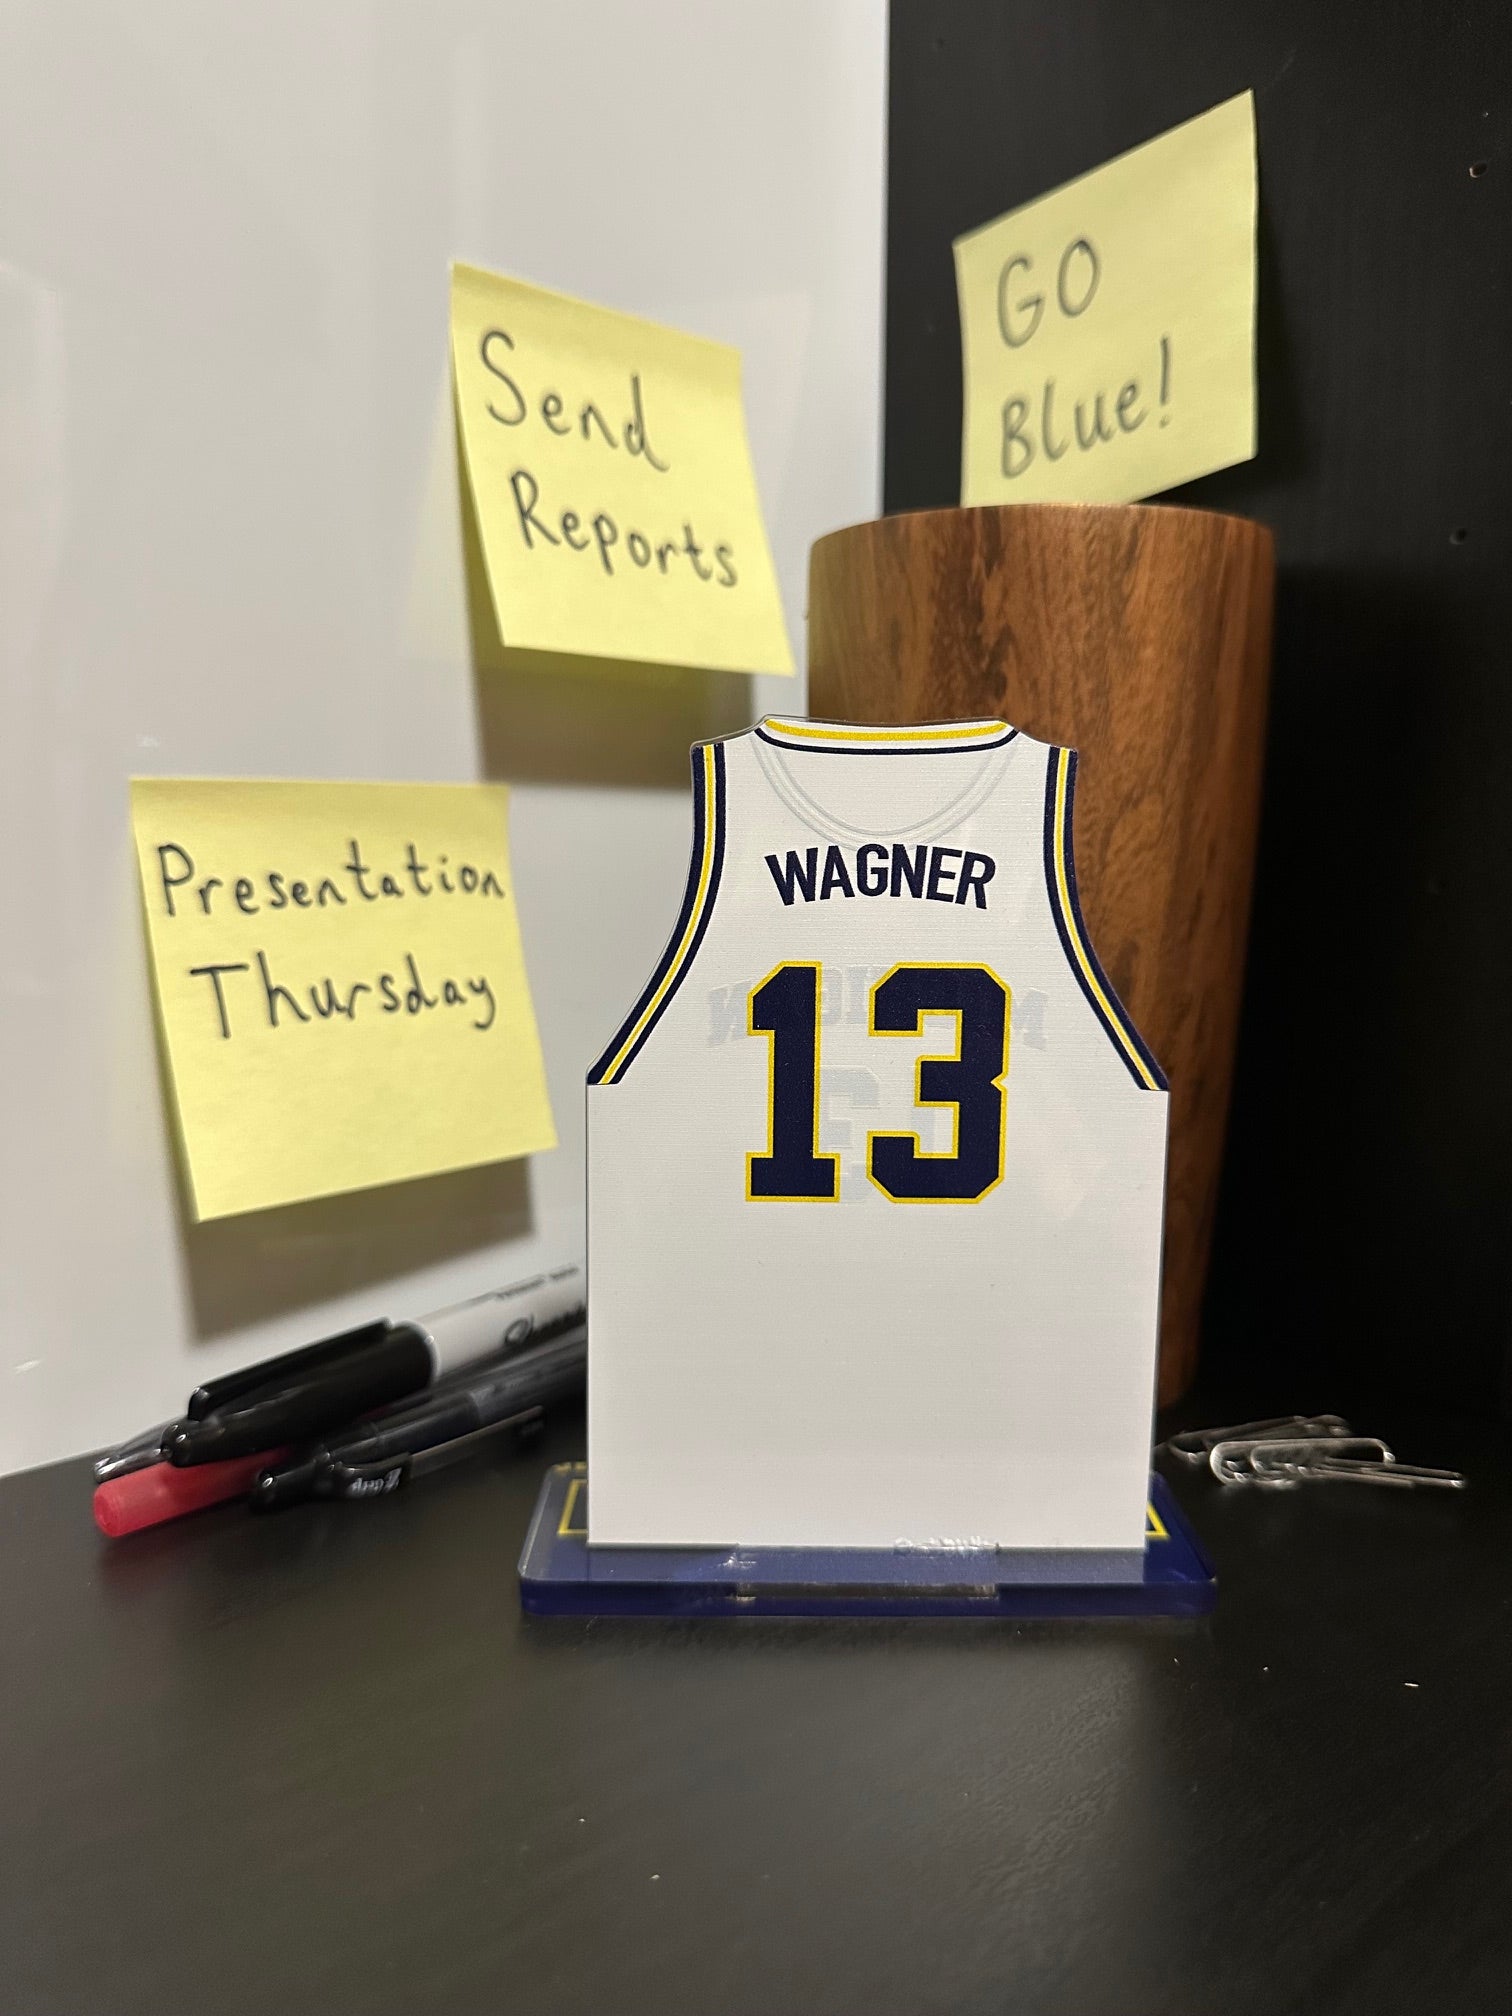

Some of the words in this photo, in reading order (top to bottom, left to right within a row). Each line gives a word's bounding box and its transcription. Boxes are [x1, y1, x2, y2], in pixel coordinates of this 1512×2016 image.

[997, 236, 1100, 348] GO
[480, 328, 671, 472] Send
[1001, 334, 1172, 479] Blue!
[510, 469, 738, 588] Reports
[156, 838, 506, 918] Presentation
[764, 843, 996, 910] WAGNER
[189, 950, 497, 1039] Thursday
[745, 960, 1012, 1204] 13
